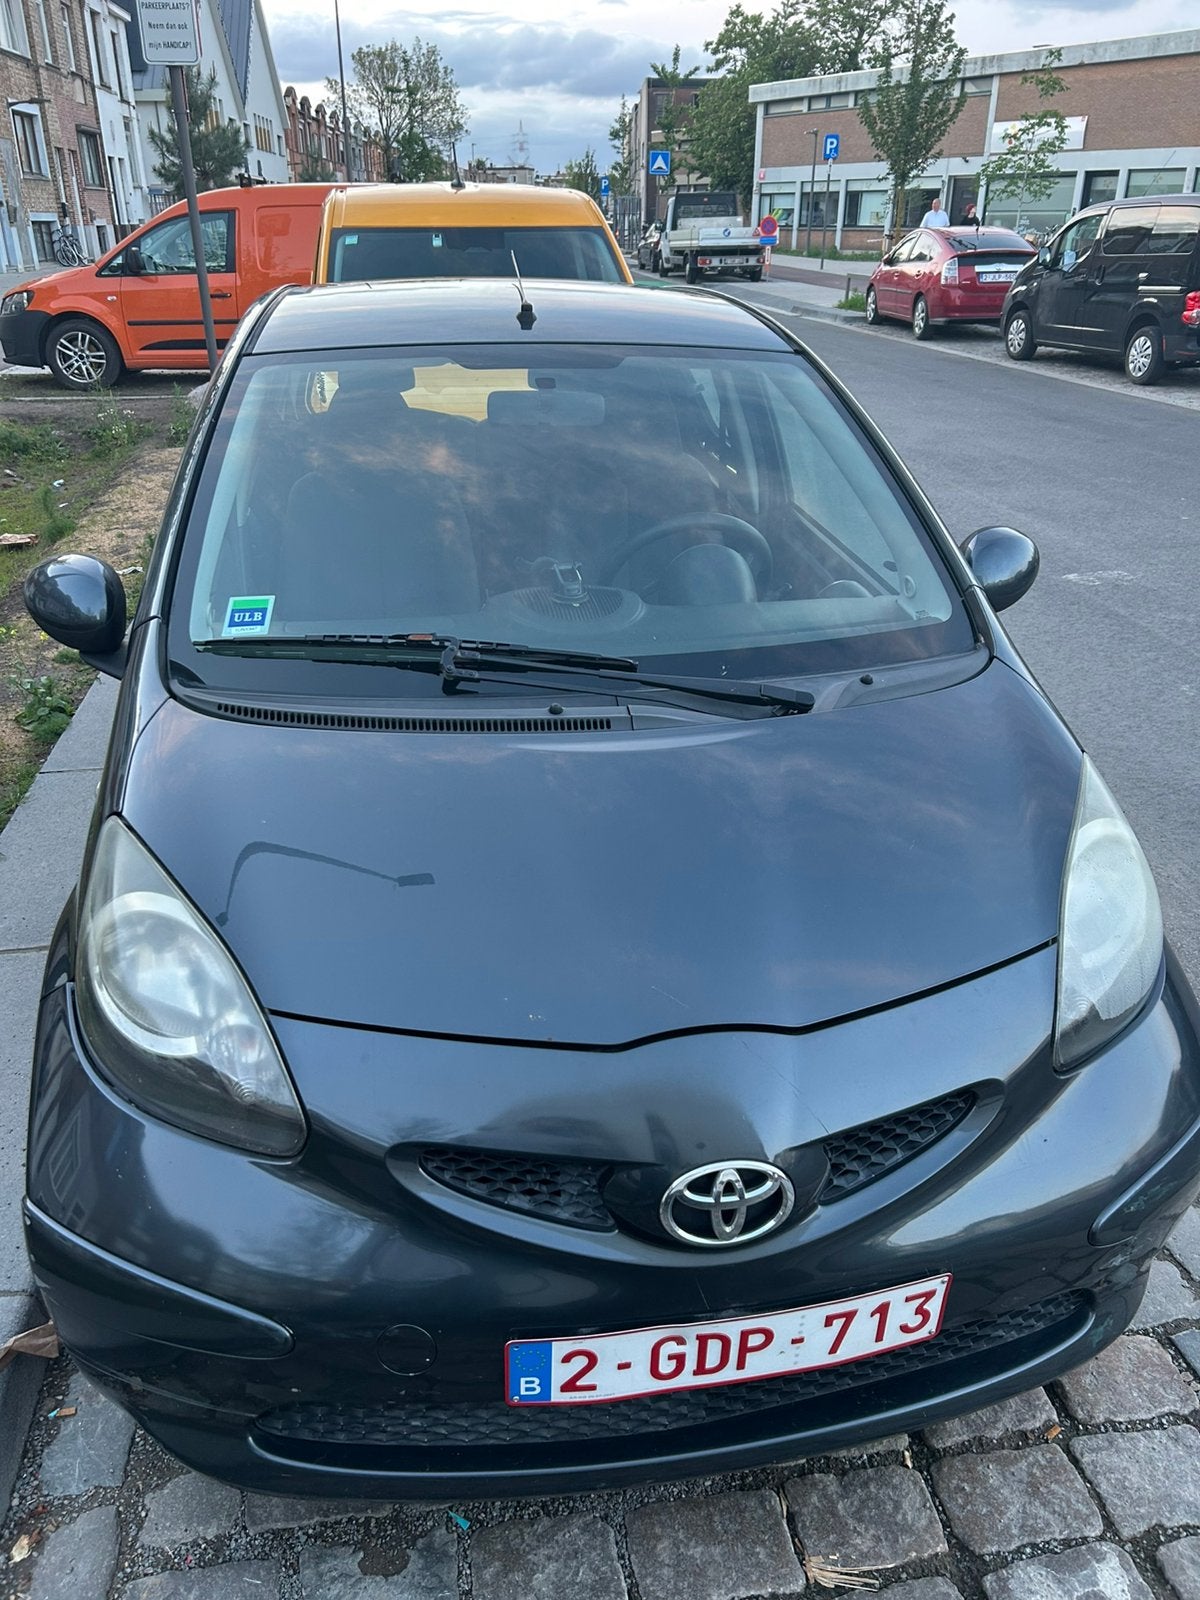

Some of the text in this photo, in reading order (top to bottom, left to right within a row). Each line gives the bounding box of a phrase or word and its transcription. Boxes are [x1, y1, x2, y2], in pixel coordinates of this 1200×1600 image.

[141, 2, 190, 10] PARKEERPLAATS?
[148, 21, 188, 30] Neem dan ook
[162, 41, 191, 49] HANDICAP!
[826, 138, 837, 154] P
[602, 179, 609, 189] P
[234, 612, 262, 622] ULB
[520, 1377, 541, 1395] B
